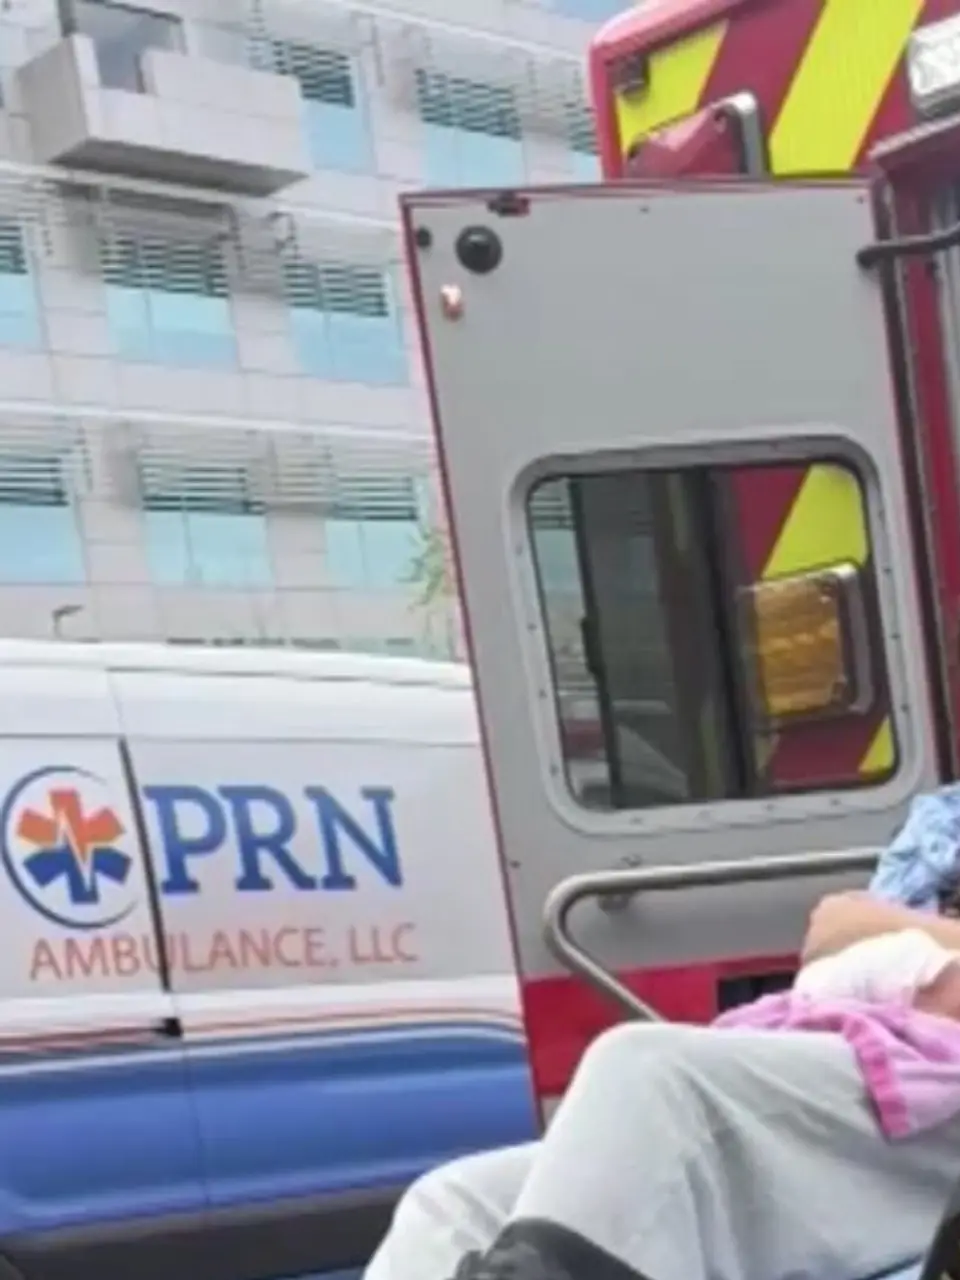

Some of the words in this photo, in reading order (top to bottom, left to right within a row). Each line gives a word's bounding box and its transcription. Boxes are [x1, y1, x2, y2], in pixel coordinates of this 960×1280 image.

[142, 784, 405, 894] PRN
[29, 926, 339, 982] AMBULANCE,
[349, 922, 419, 965] LLC
